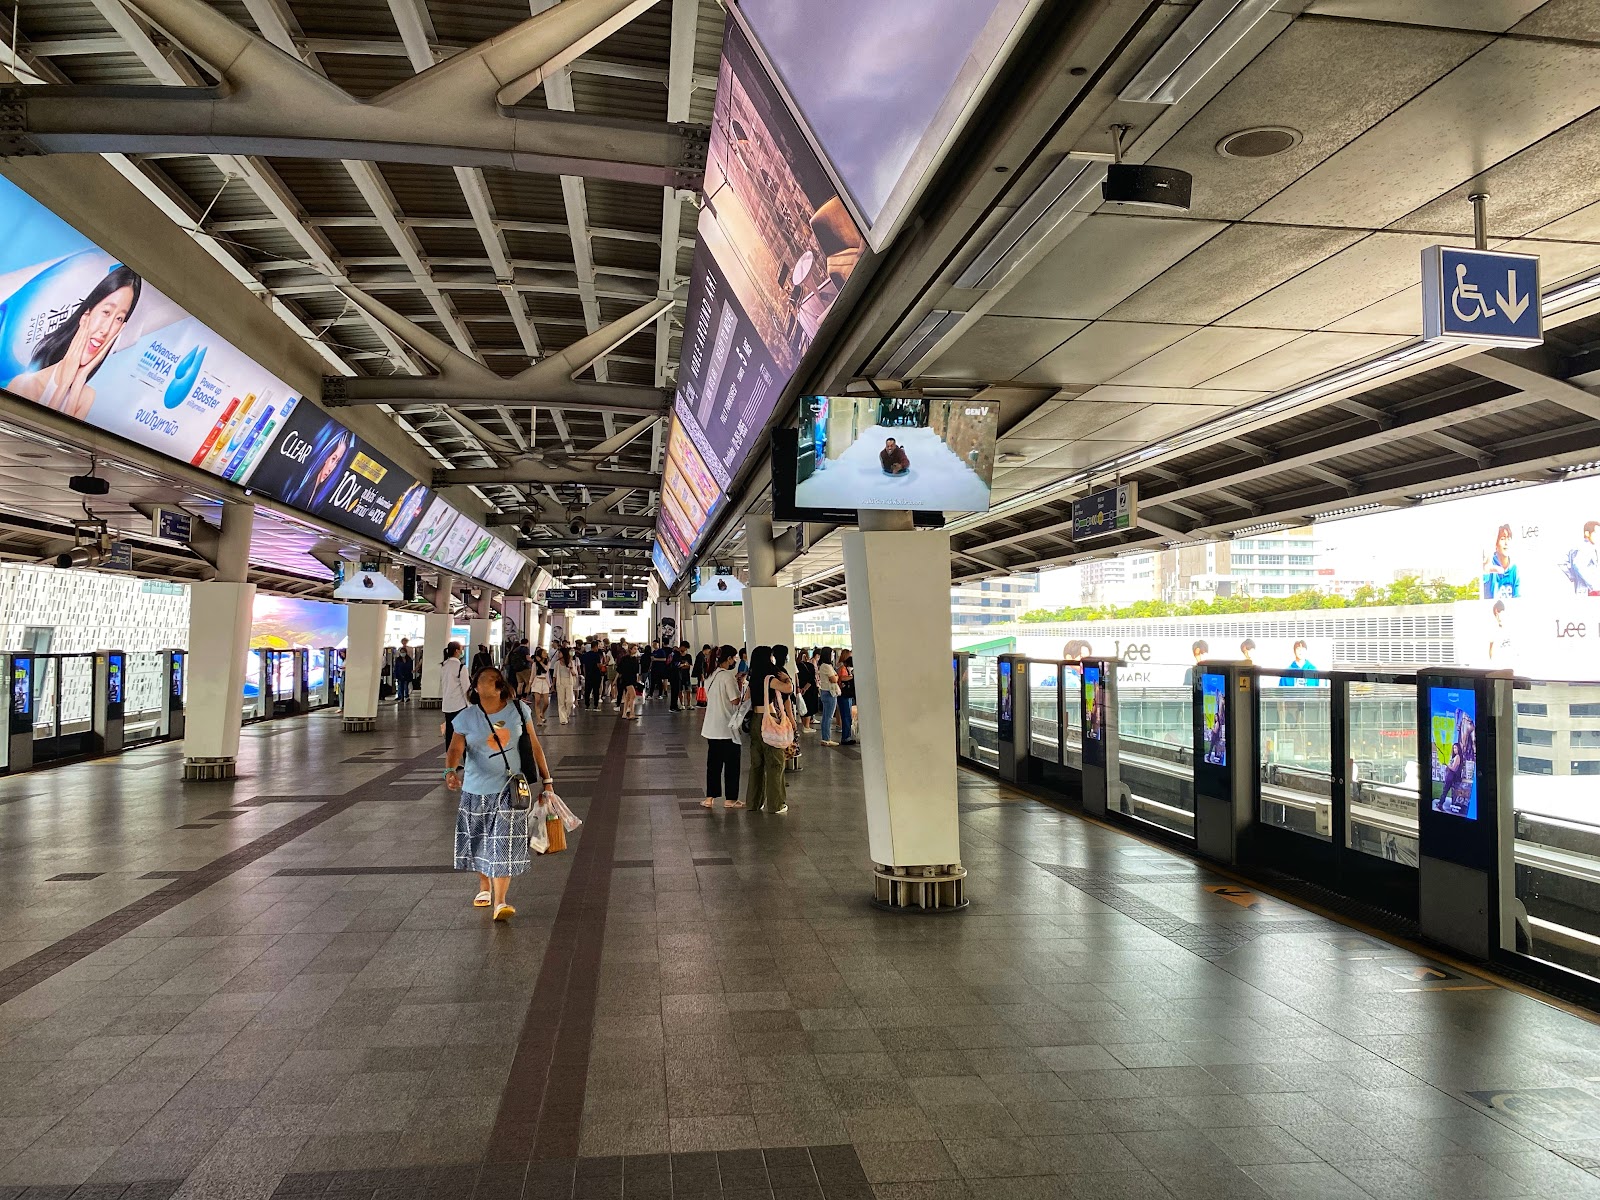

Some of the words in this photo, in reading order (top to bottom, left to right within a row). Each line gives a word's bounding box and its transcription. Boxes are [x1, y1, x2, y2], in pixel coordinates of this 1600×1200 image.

[704, 269, 717, 301] ARI
[695, 297, 712, 347] AROUND
[150, 340, 180, 364] Advanced
[690, 343, 703, 379] NOBLE
[736, 346, 748, 367] 5
[153, 357, 172, 377] HYA
[200, 377, 216, 391] Power
[192, 386, 220, 409] Booster
[135, 408, 179, 436] จบปัญหาผิว
[280, 430, 313, 464] CLEAR
[329, 470, 361, 510] 10X
[1120, 492, 1127, 508] 2
[1522, 526, 1539, 538] Lee
[1556, 619, 1586, 638] Lee
[1115, 640, 1151, 661] Lee
